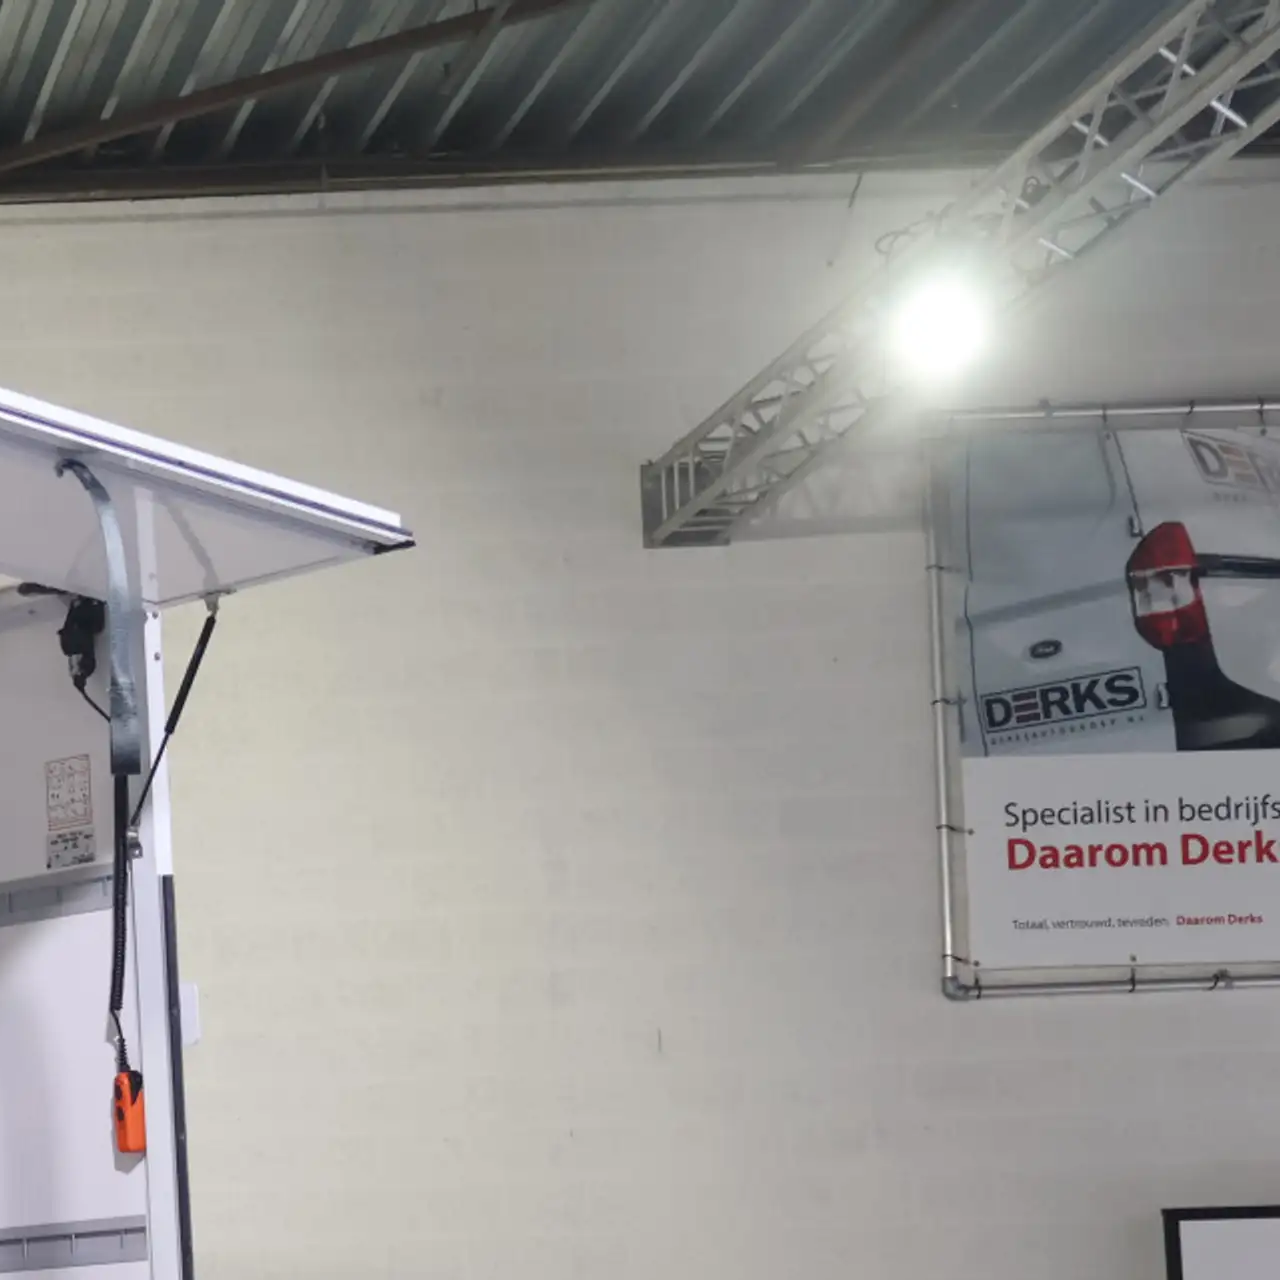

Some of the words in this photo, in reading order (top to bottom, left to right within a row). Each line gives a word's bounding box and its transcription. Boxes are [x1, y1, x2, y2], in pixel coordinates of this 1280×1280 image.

[985, 674, 1140, 728] DERKS
[1004, 799, 1136, 833] Specialist
[1144, 799, 1169, 823] in
[1178, 794, 1280, 826] bedrijfs
[1007, 838, 1168, 870] Daarom
[1176, 914, 1226, 926] Daarom
[1227, 913, 1264, 925] Derks
